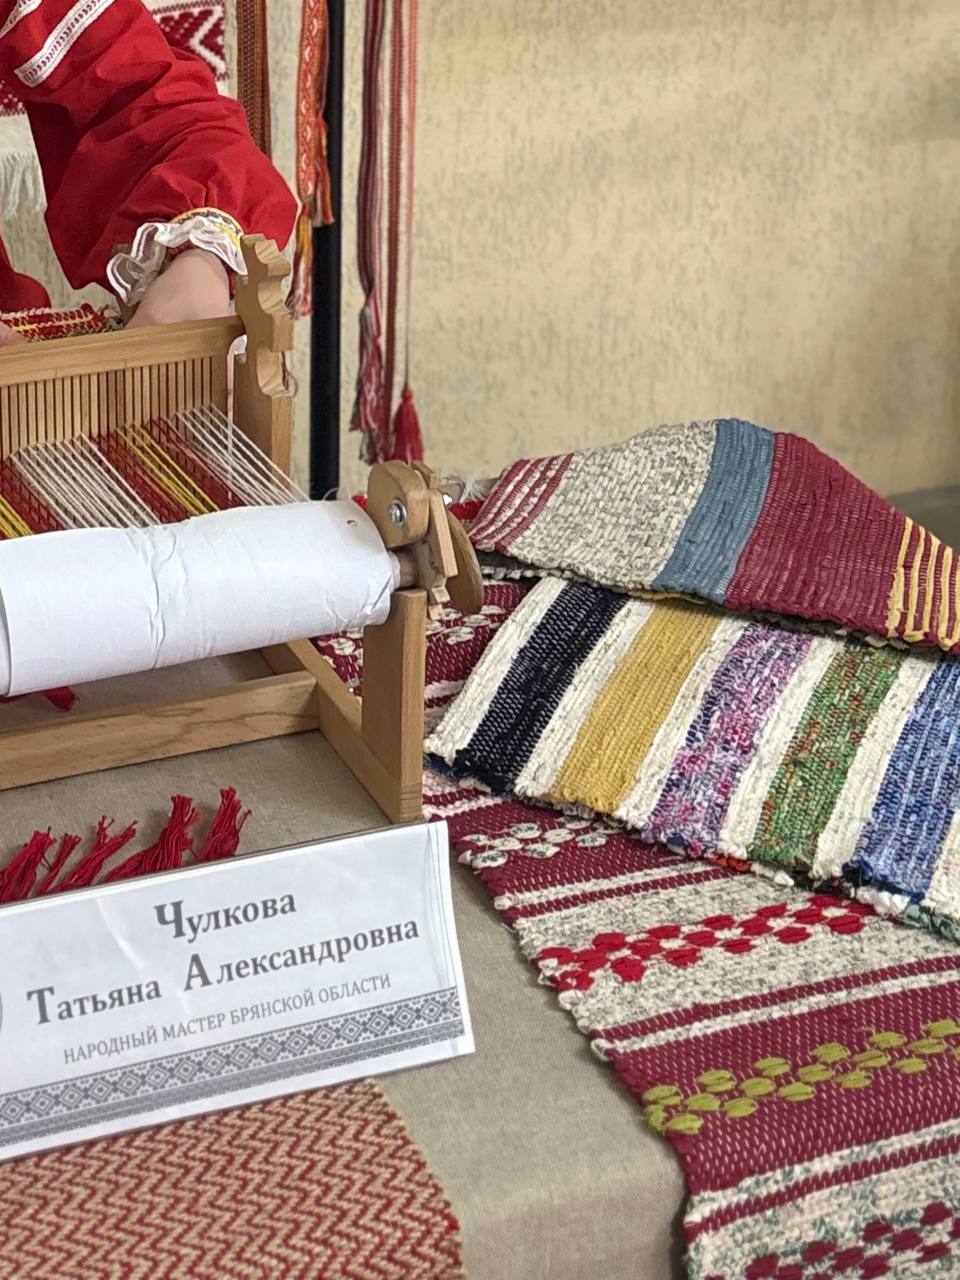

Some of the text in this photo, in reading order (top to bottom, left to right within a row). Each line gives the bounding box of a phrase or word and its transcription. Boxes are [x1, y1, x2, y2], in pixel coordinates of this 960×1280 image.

[153, 893, 297, 944] Чулкова
[26, 919, 420, 1025] Татьяна Александровна
[63, 973, 392, 1064] НАРОДНЫЙ МАСТЕР БРЯНСКОЙ ОБЛАСТИ
